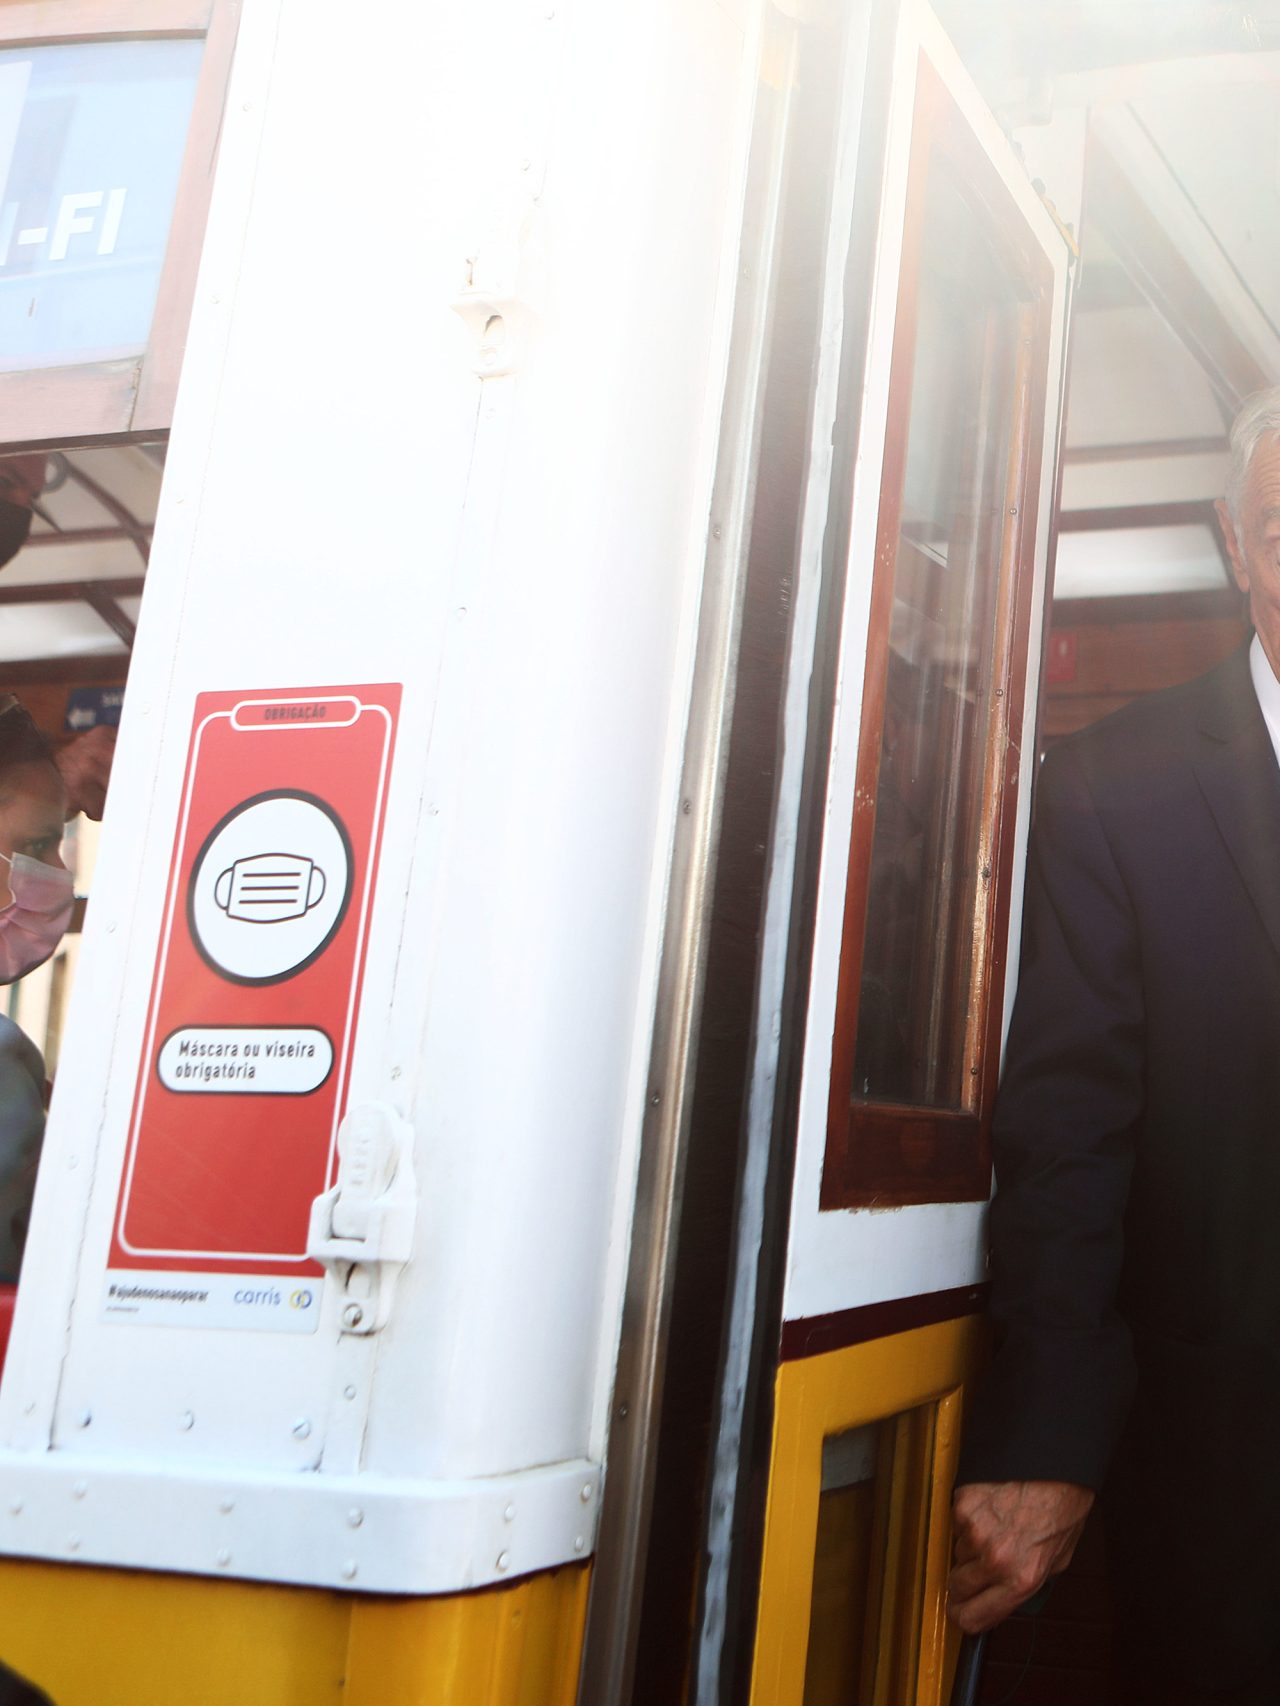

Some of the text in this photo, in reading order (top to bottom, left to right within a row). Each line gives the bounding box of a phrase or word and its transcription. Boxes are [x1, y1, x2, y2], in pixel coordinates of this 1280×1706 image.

[264, 703, 327, 721] OBRIGAÇÃO
[178, 1040, 316, 1058] Máscara ou viseira
[175, 1062, 257, 1082] obrigatória
[233, 1286, 281, 1306] carris
